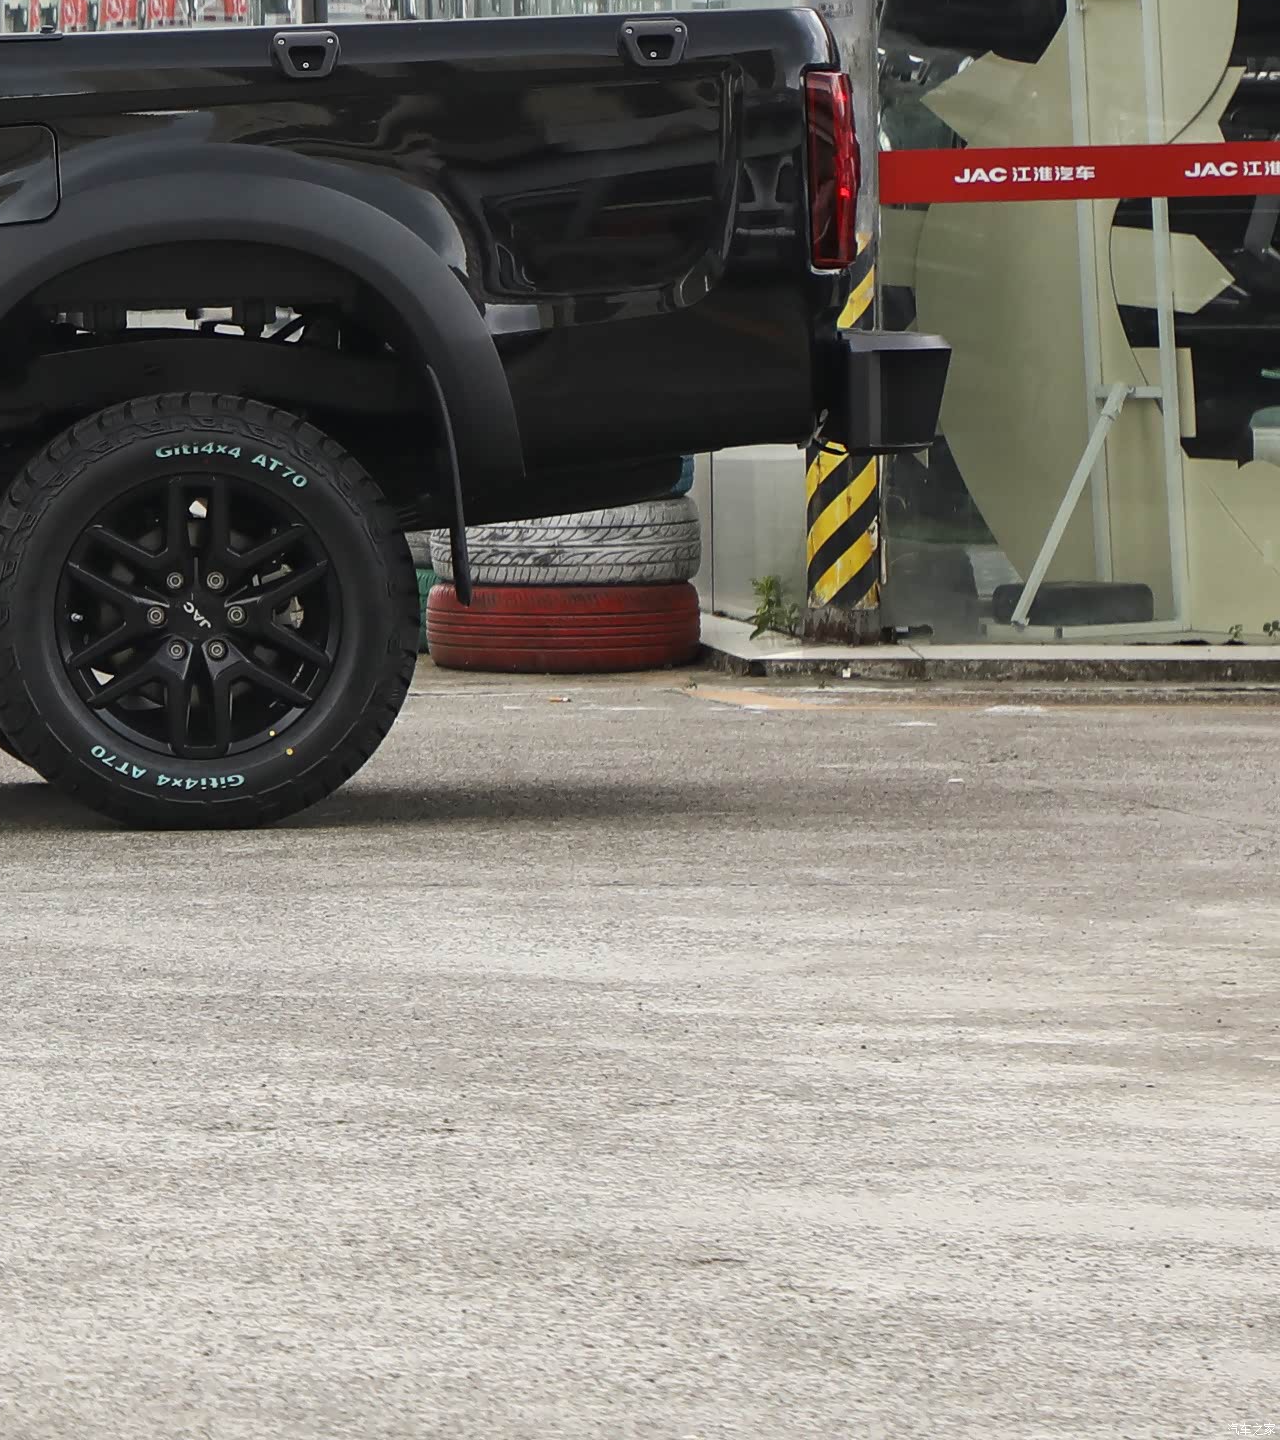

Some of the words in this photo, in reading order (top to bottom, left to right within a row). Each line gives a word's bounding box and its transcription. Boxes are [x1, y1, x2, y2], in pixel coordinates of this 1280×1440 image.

[954, 167, 1007, 183] JAC
[1012, 166, 1095, 182] 江淮汽车
[1184, 161, 1238, 177] JAC
[155, 441, 241, 459] Giti4x4
[251, 453, 308, 488] AT70
[183, 601, 212, 629] JAC
[90, 745, 147, 779] AT70
[156, 774, 245, 790] Giti4x4
